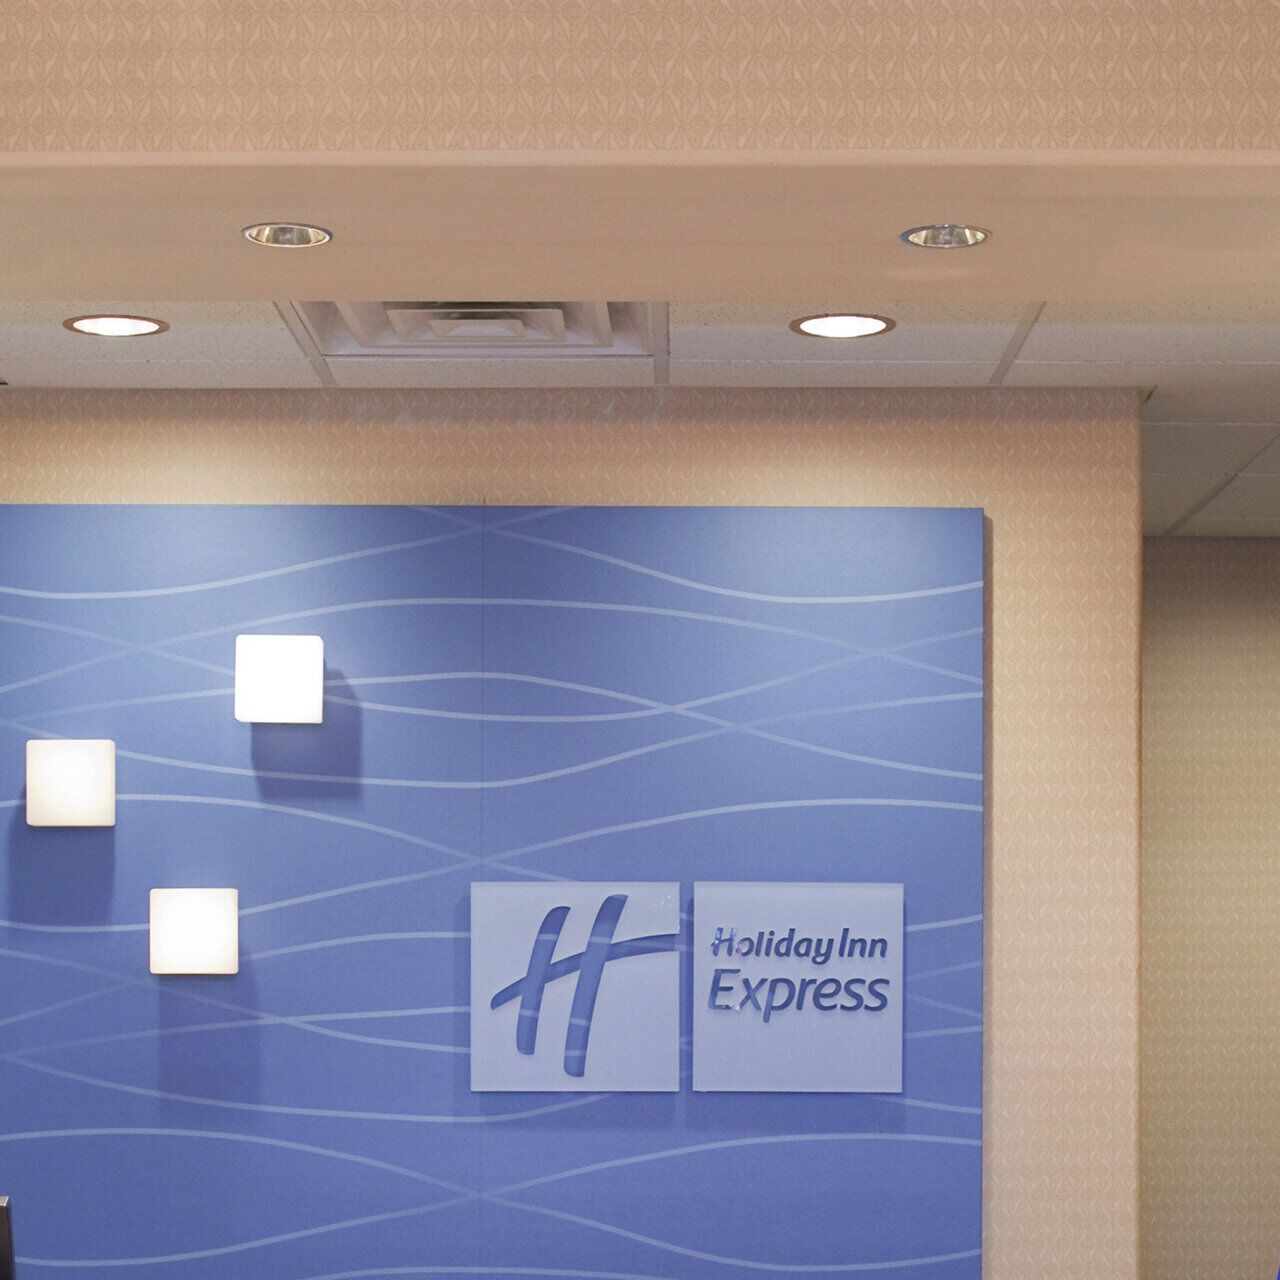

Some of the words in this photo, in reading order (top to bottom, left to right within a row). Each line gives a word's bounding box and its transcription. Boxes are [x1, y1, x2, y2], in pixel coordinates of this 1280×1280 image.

[710, 926, 835, 966] Holiday
[838, 927, 888, 959] Inn
[707, 968, 891, 1024] Express
